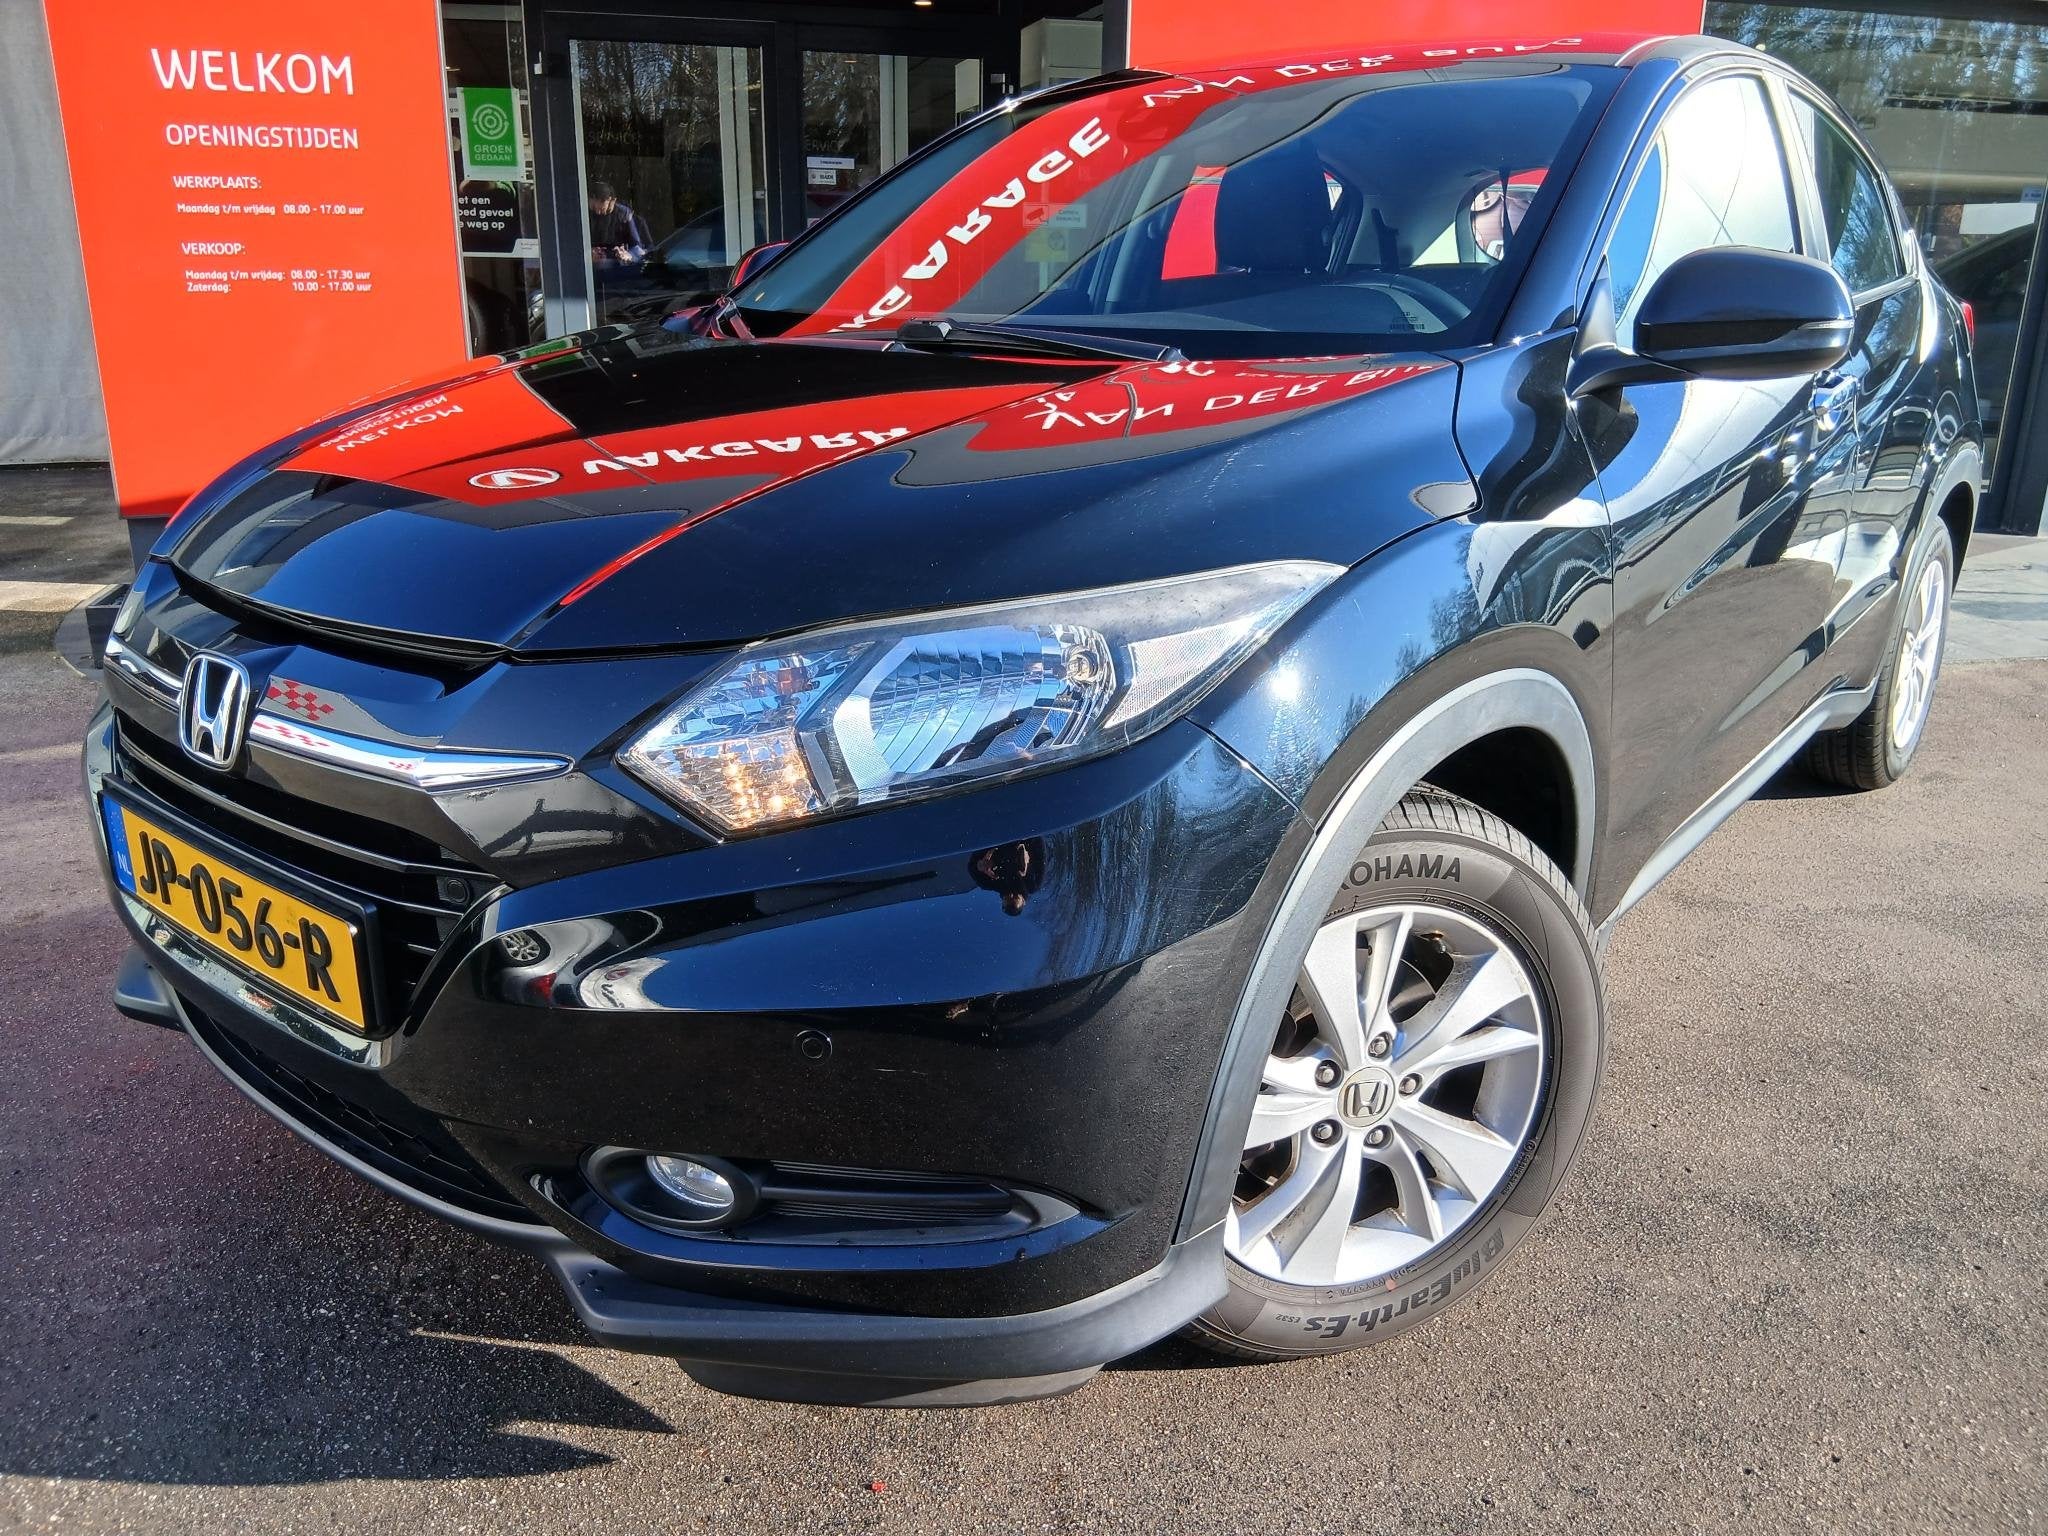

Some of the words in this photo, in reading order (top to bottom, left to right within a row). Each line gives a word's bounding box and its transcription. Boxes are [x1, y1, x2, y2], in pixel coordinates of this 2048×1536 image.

[150, 47, 354, 96] WELKOM
[165, 123, 359, 149] OPENINGSTIJDEN
[473, 144, 513, 154] GROEN
[172, 175, 262, 189] WERKPLAATS:
[459, 196, 469, 204] et
[471, 197, 491, 205] een
[176, 203, 220, 214] Maandag
[222, 203, 241, 214] t/m
[243, 204, 276, 216] vrijdag
[282, 204, 310, 214] 08.00
[319, 204, 346, 215] 17.00
[348, 206, 364, 215] uur
[459, 207, 476, 217] oed
[479, 208, 514, 219] gevoel
[466, 221, 489, 231] weg
[491, 221, 505, 230] op
[181, 242, 246, 255] VERKOOP:
[185, 270, 228, 281] Maandag
[230, 269, 249, 280] t/m
[250, 270, 286, 282] vrijdag:
[290, 269, 318, 280] 08.00
[326, 269, 353, 280] 17.30
[355, 271, 371, 280] uur
[186, 281, 232, 294] Zaterdag:
[292, 281, 319, 292] 10.00
[328, 281, 355, 292] 17.00
[356, 282, 372, 292] uur
[117, 851, 132, 875] NL
[1340, 853, 1461, 890] OHAMA
[138, 831, 341, 1002] JP-056-R
